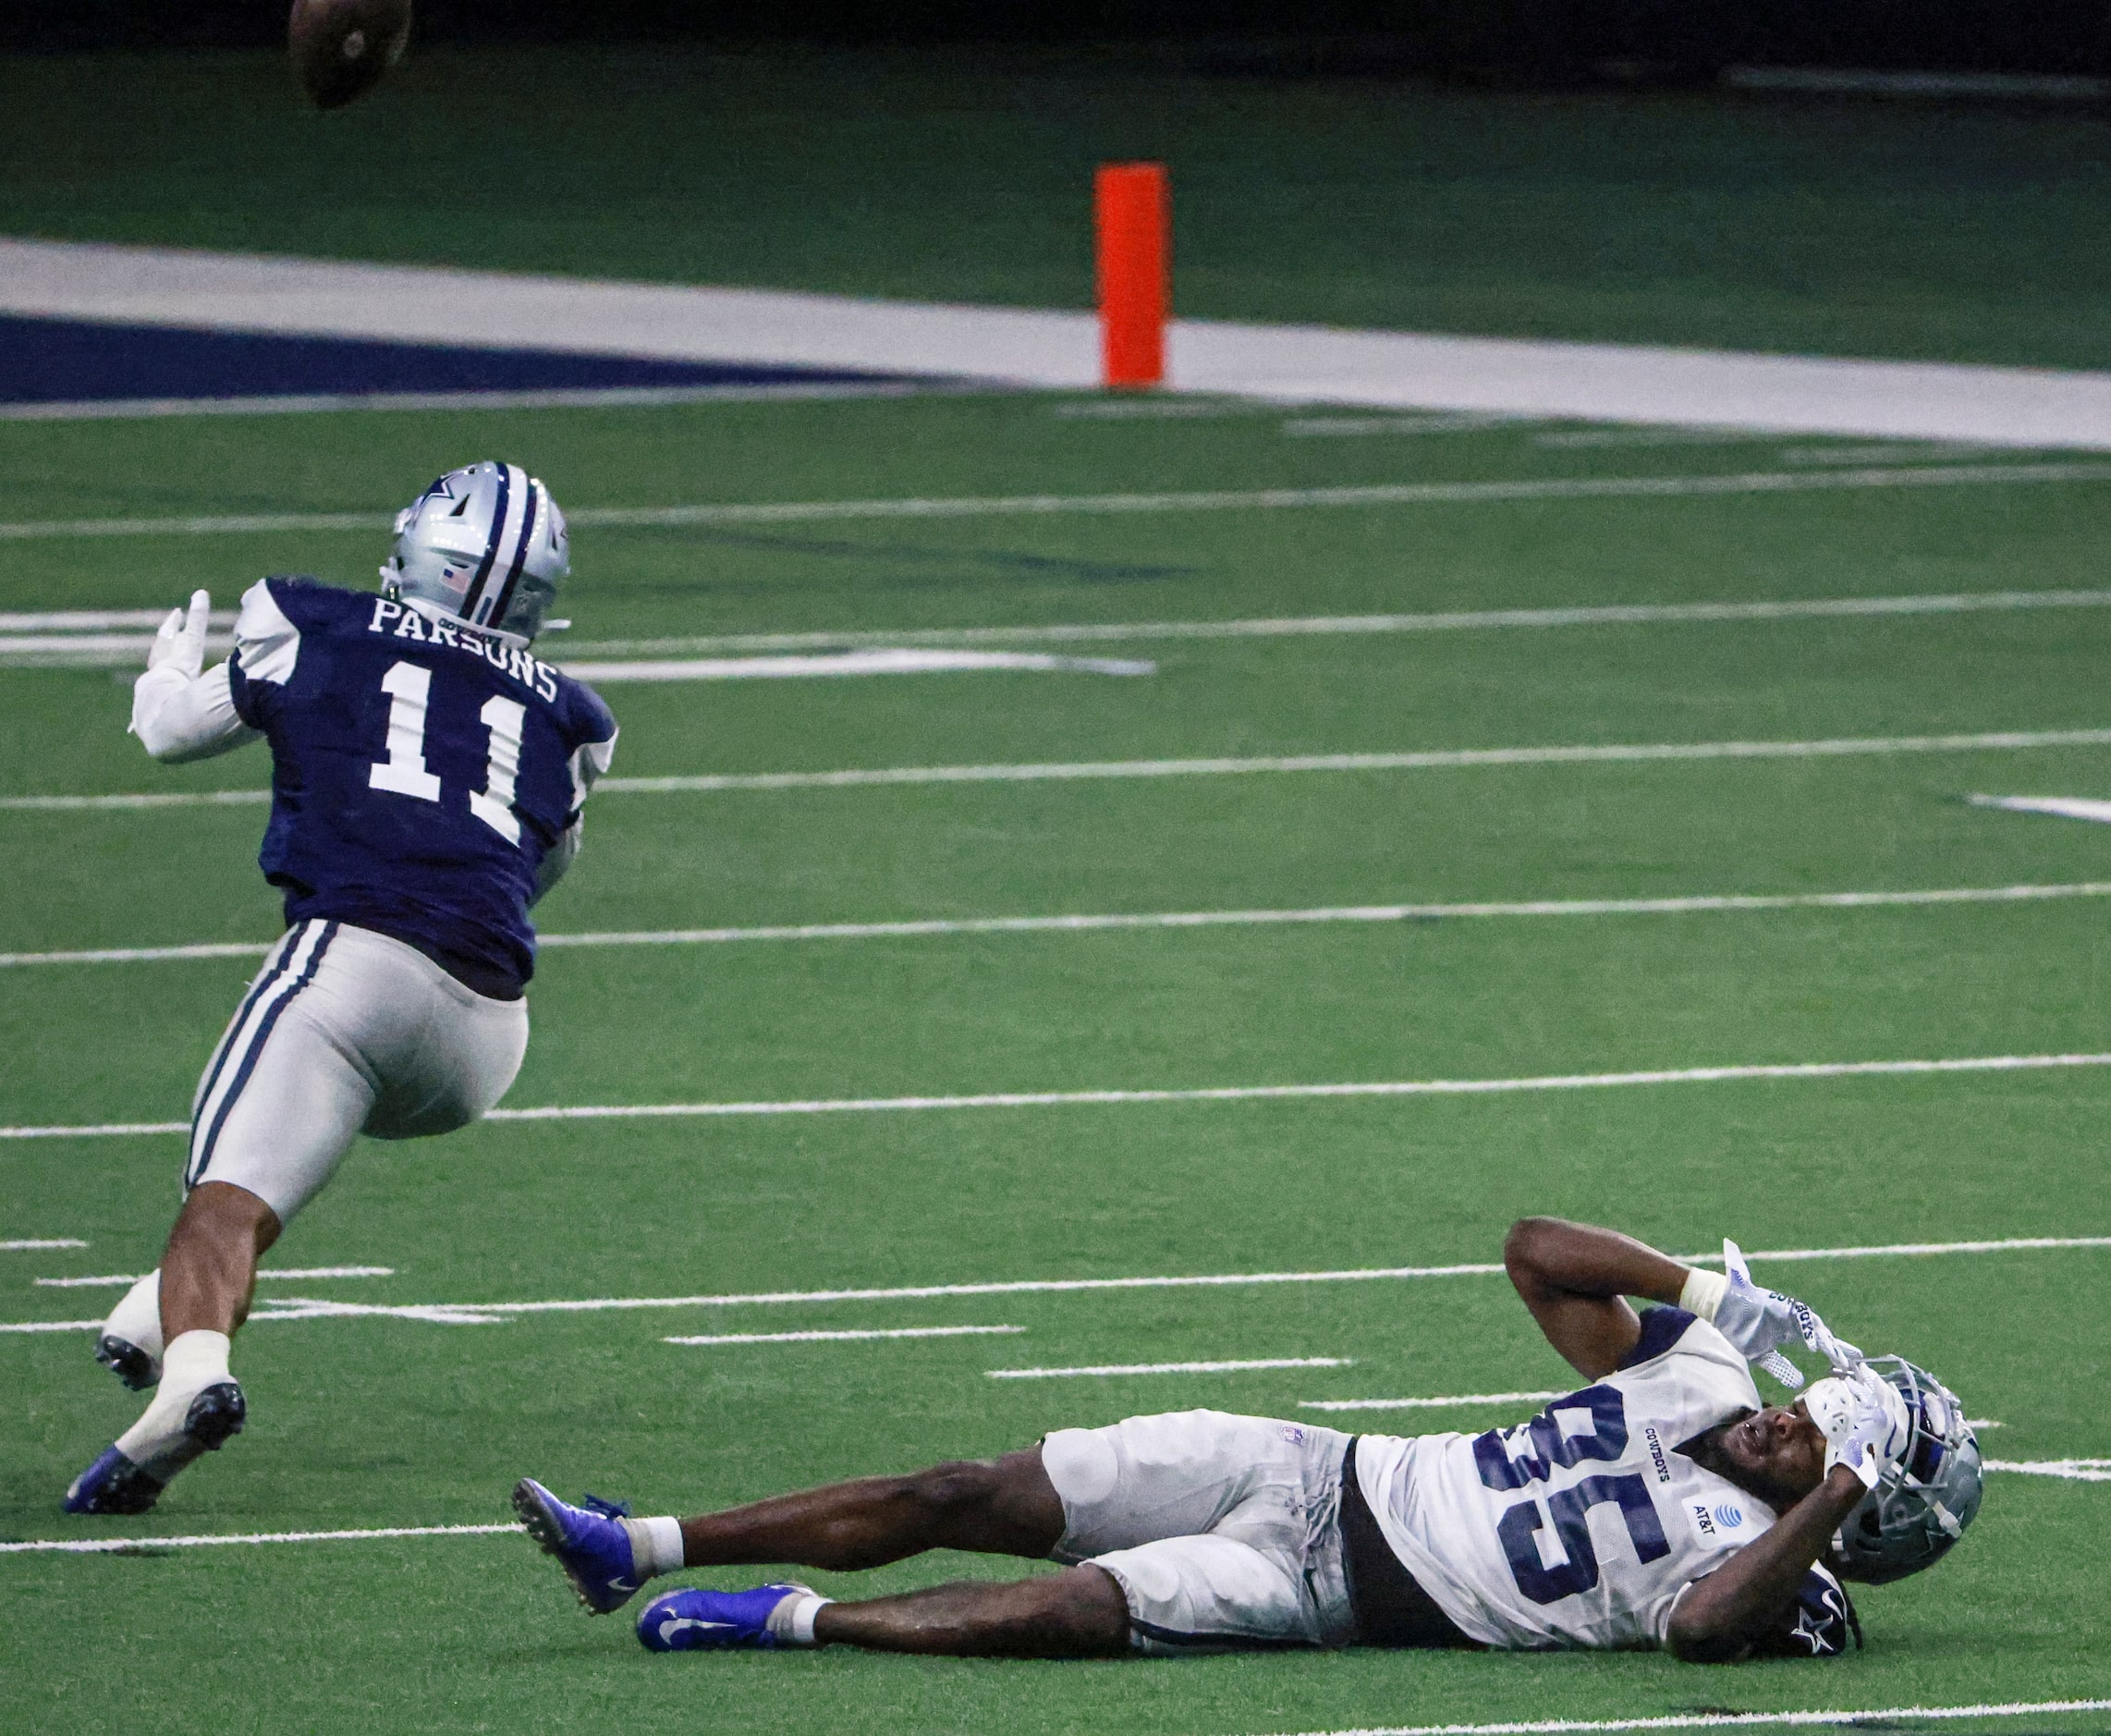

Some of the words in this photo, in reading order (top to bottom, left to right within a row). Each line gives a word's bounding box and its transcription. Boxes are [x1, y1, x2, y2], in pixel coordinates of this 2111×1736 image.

[368, 598, 558, 703] PARSONS
[368, 660, 526, 848] 11
[1645, 1427, 1670, 1483] COWBOYS
[1693, 1506, 1715, 1535] AT&T
